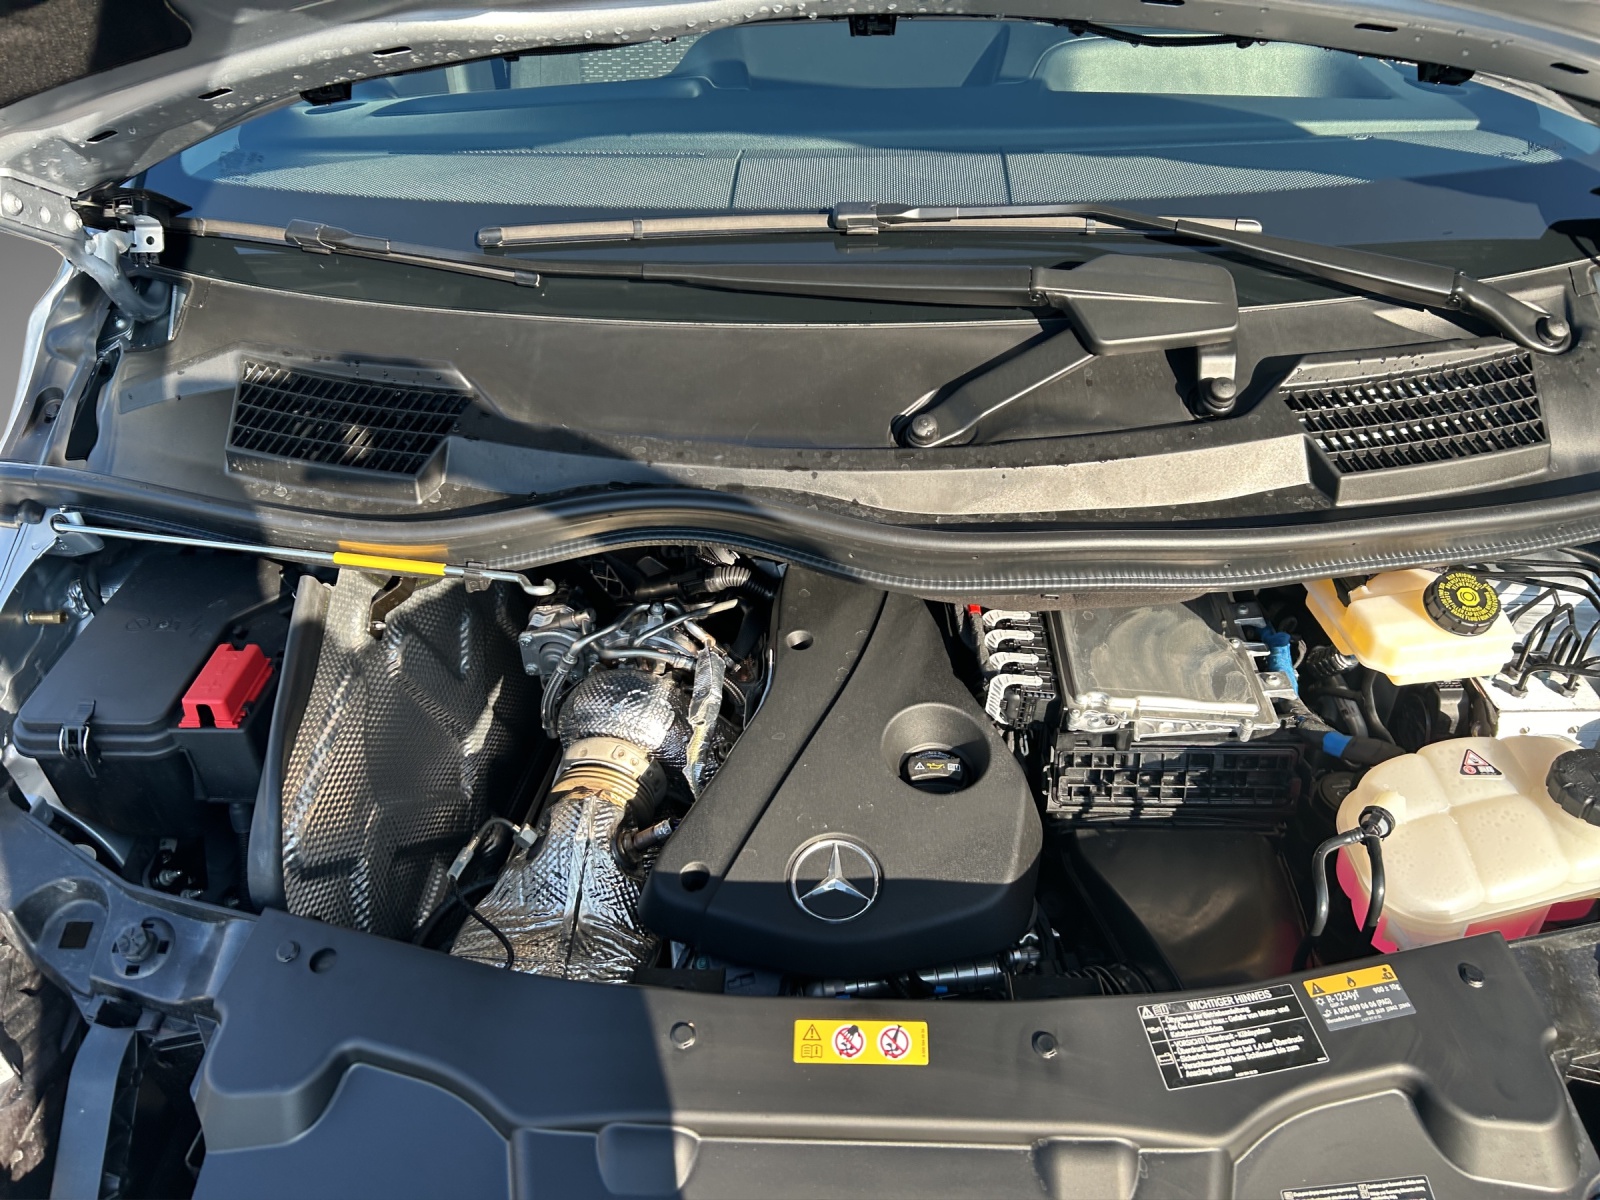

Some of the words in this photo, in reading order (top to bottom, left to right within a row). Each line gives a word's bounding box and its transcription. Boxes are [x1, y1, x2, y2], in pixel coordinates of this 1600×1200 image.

[1187, 996, 1235, 1011] WICHTIGER
[1233, 990, 1273, 1005] HINWEIS
[1325, 989, 1360, 1002] R-1234yf
